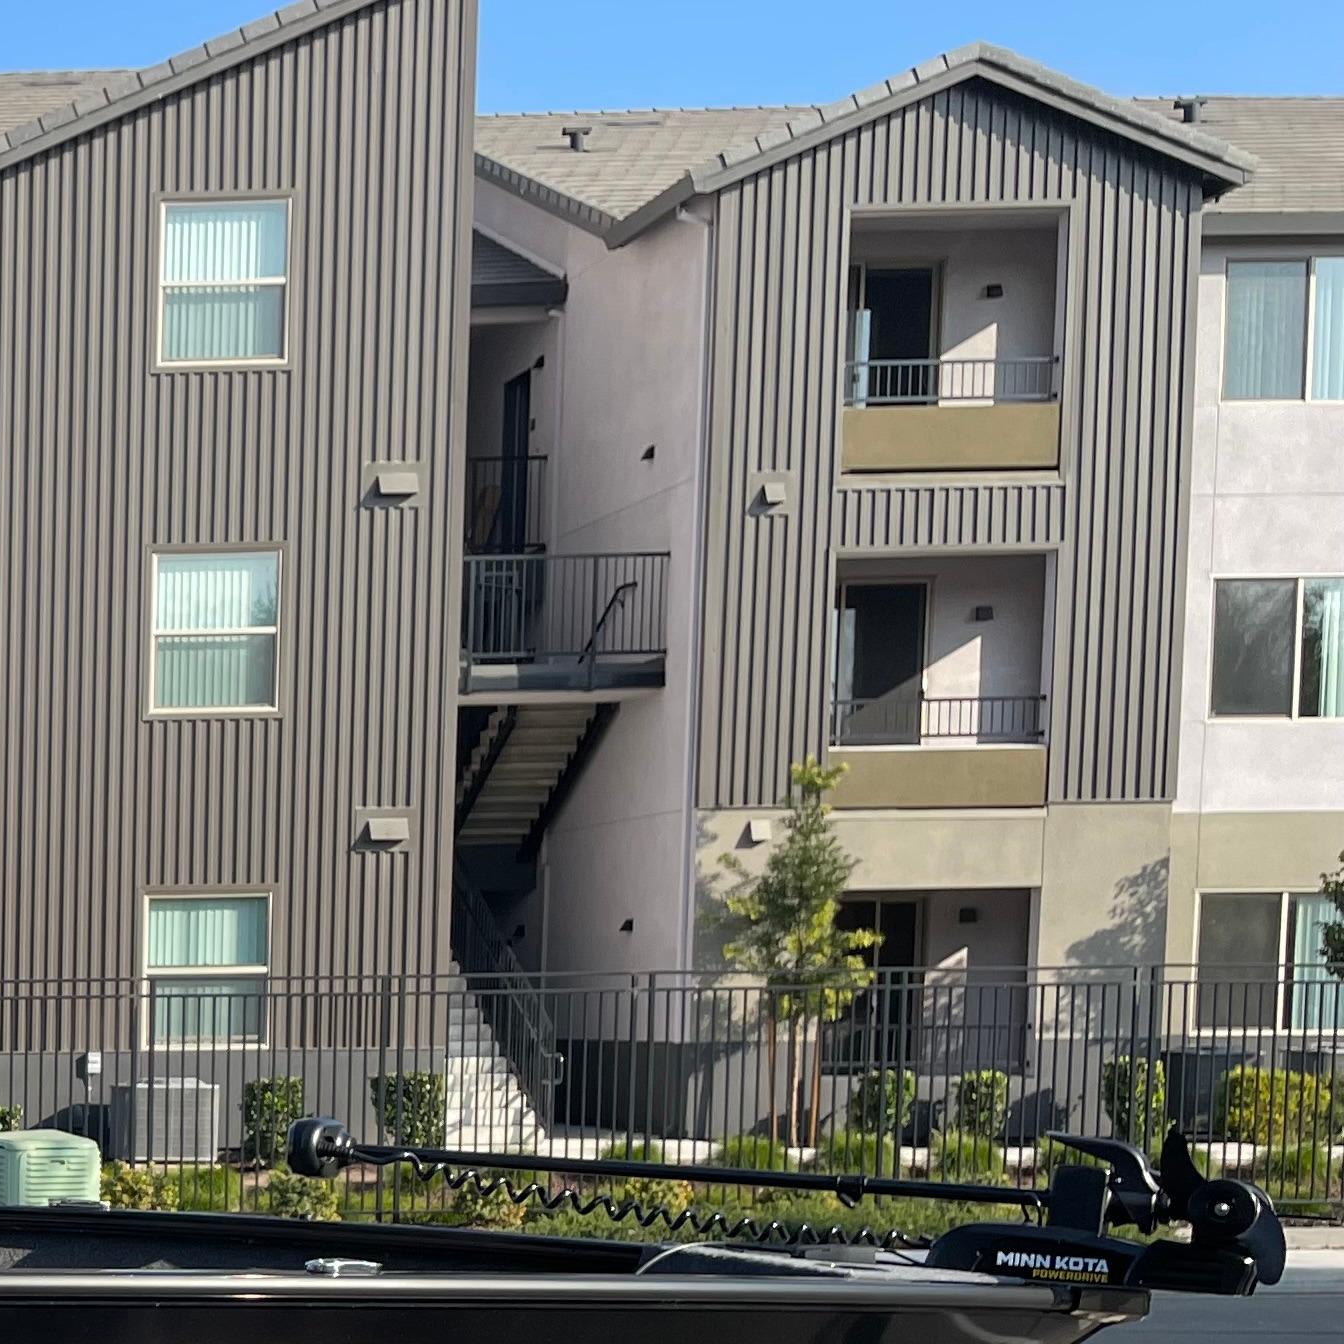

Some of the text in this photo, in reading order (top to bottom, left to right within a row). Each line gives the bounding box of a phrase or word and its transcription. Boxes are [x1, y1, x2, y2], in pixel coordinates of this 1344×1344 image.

[996, 1250, 1109, 1273] MINN KOTA
[1032, 1268, 1108, 1284] POWERDRIVE
